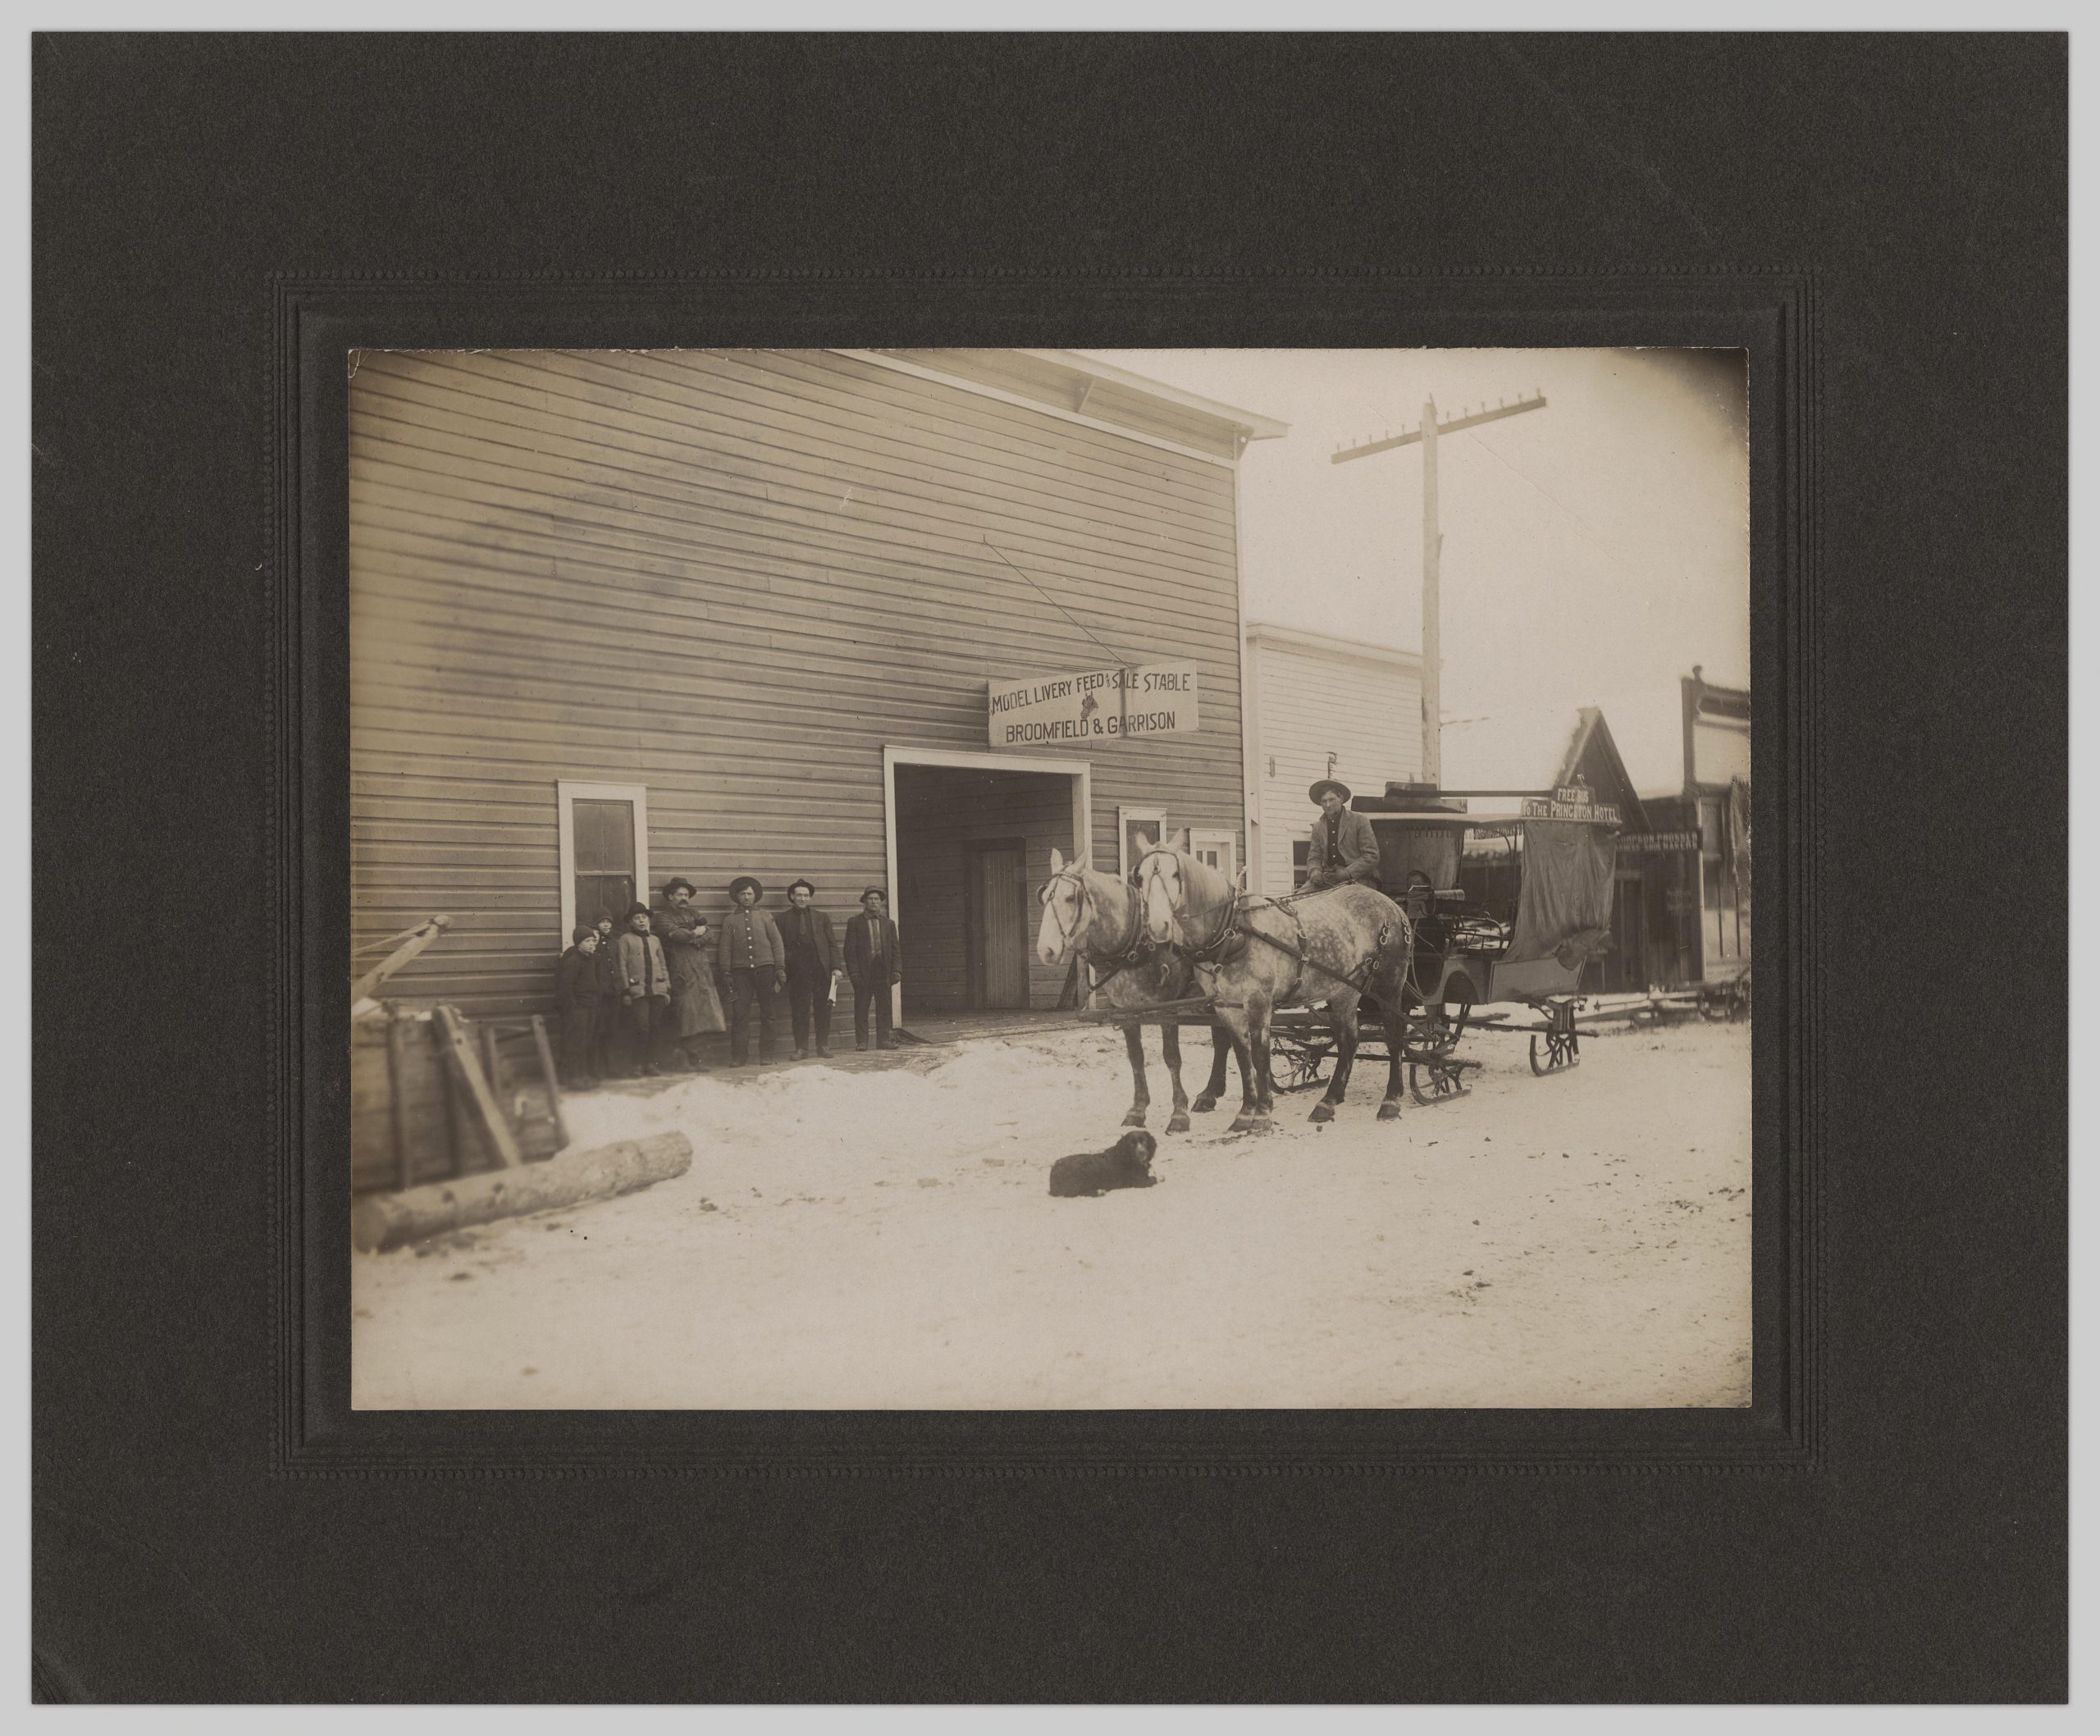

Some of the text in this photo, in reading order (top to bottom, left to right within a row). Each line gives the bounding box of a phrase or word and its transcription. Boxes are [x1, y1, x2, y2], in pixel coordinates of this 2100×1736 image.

[991, 689, 1032, 715] MODEL
[1034, 680, 1072, 703] LIVERY
[1076, 673, 1104, 693] FEED
[1112, 672, 1139, 689] SALE
[1144, 673, 1191, 692] STABLE
[1006, 711, 1176, 742] BROOMFIELD & GARRISON
[1557, 788, 1589, 803] FREE BUS
[1532, 802, 1548, 816] THE
[1550, 801, 1592, 820] PRINCETON
[1594, 803, 1618, 821] HOTEL
